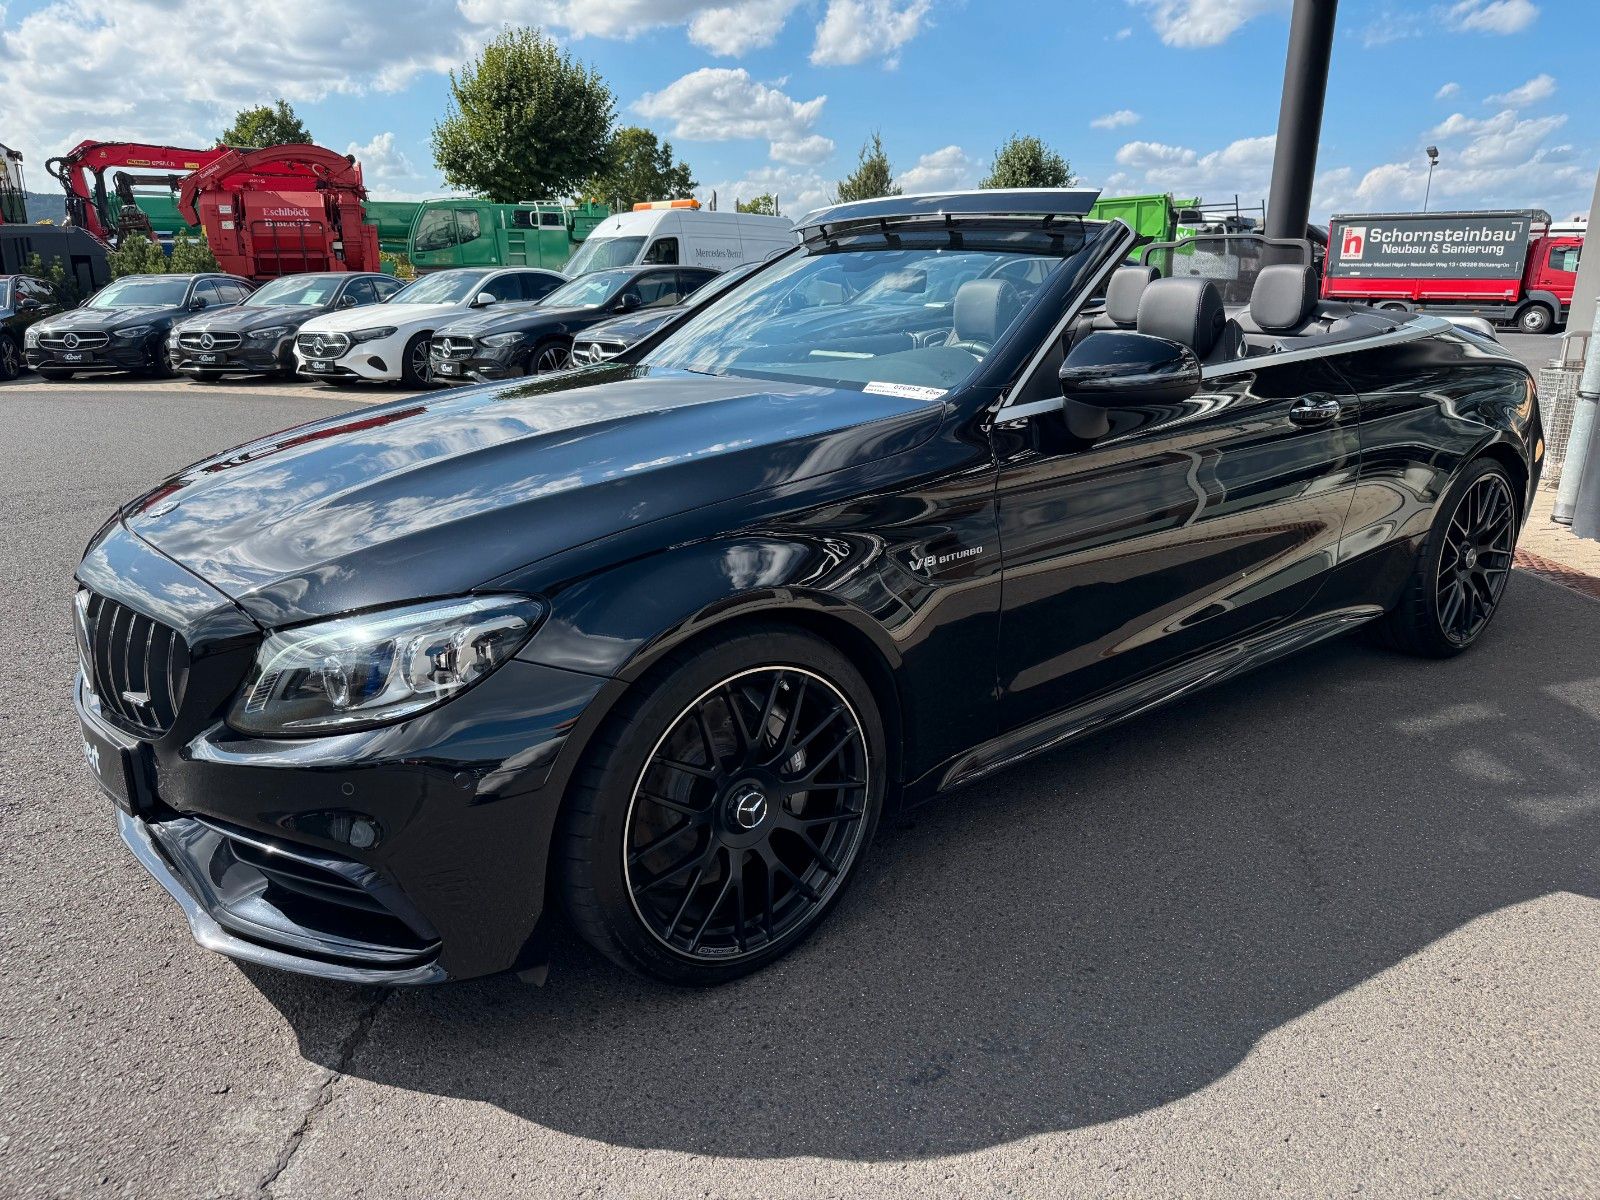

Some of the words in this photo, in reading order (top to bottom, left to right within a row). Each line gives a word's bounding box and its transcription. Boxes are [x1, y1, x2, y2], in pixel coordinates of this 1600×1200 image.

[263, 208, 309, 217] Eschlböck
[1369, 227, 1516, 243] Schornsteinbau
[695, 248, 743, 258] Mercedes-Benz
[1382, 244, 1427, 254] Neubau
[1429, 244, 1439, 254] &
[1442, 243, 1504, 256] Sanierung
[908, 555, 937, 571] V8
[939, 546, 983, 564] BITURBO
